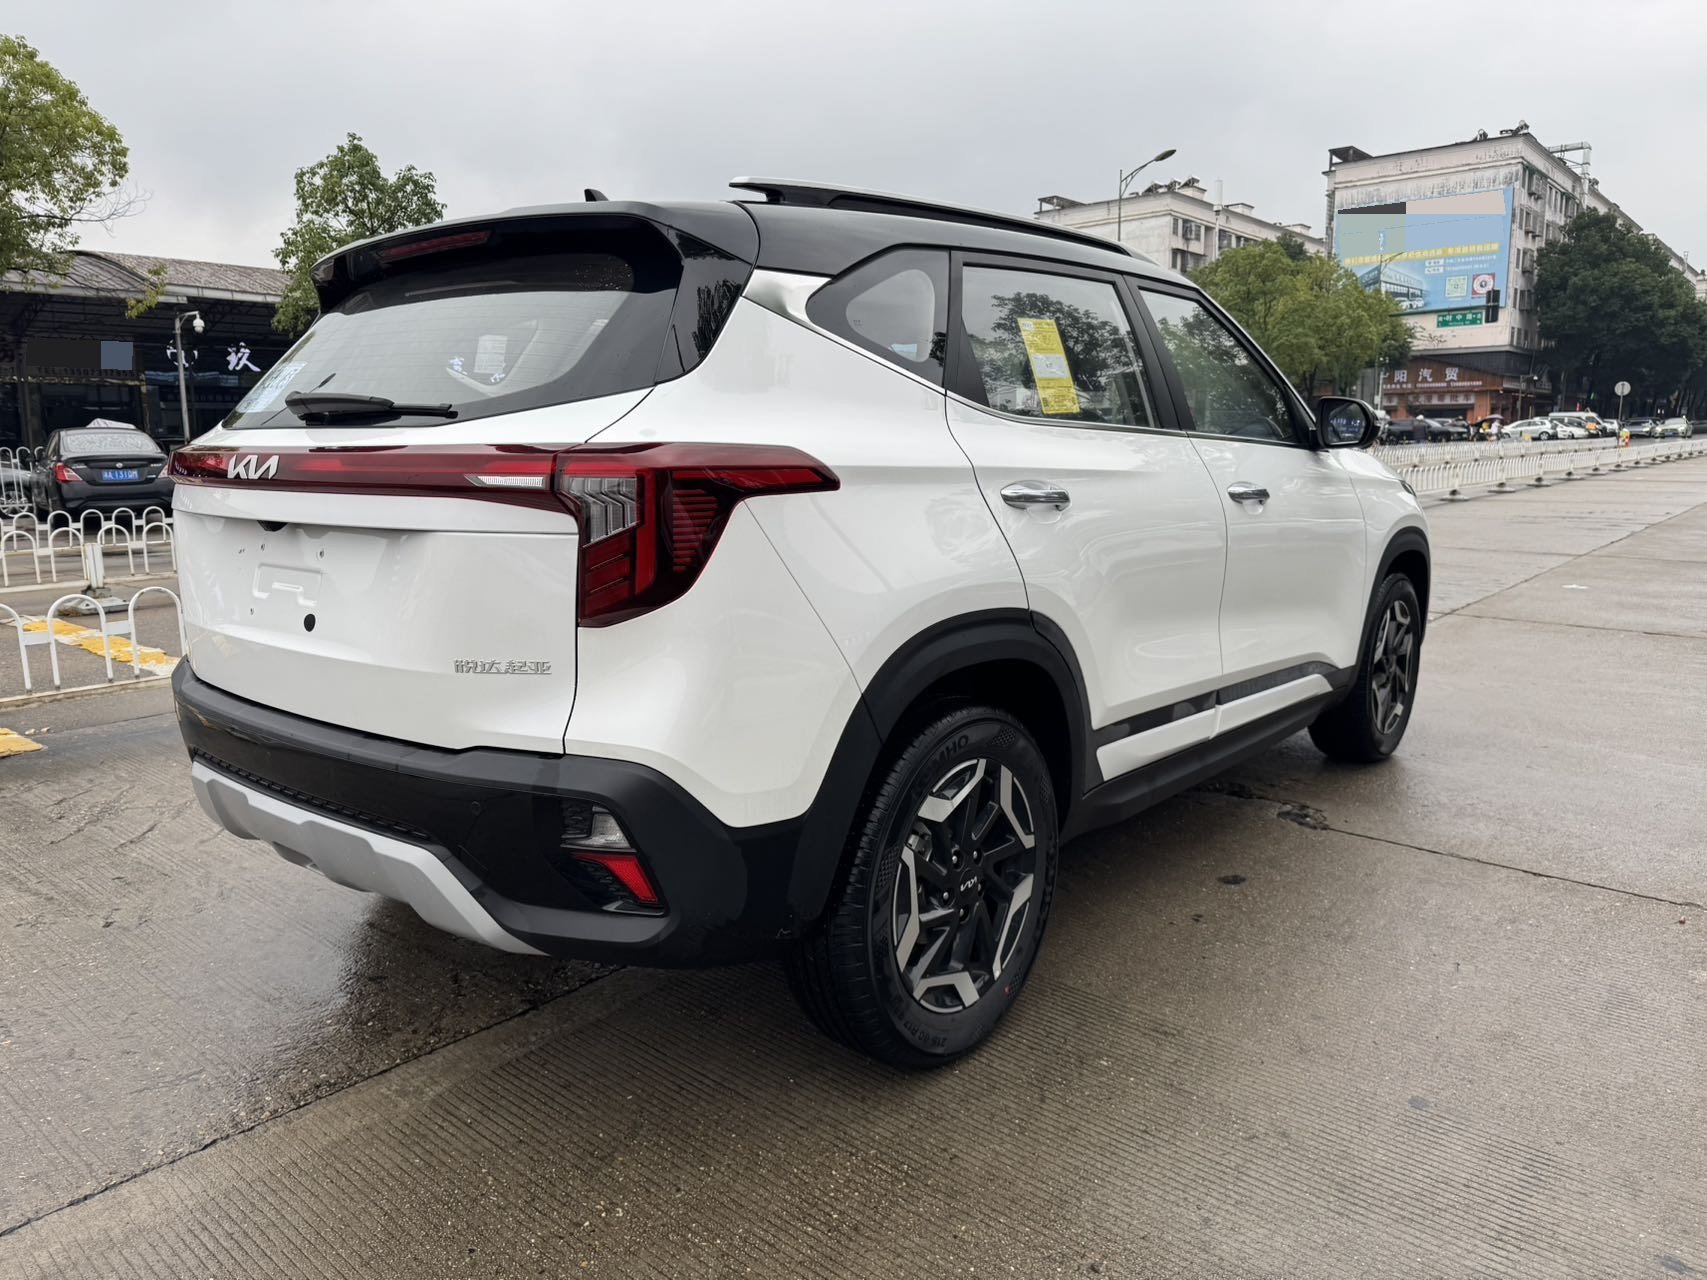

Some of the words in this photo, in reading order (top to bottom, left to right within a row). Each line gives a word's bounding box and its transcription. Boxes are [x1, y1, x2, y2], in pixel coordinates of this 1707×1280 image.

[227, 454, 280, 480] KIA
[454, 659, 552, 675] 悦达起亚
